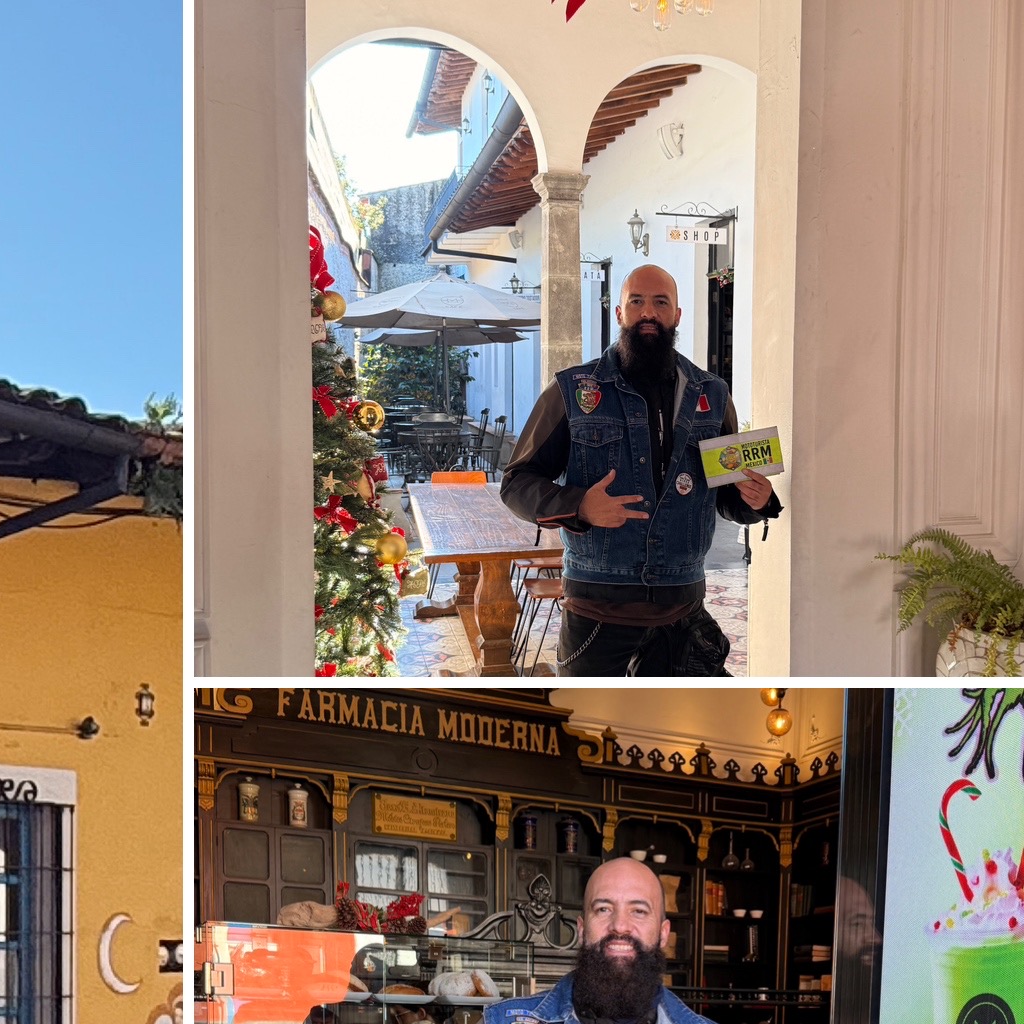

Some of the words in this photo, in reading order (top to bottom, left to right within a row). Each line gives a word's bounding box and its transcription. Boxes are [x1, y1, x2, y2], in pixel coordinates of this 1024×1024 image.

[683, 229, 720, 242] SHOP
[583, 271, 601, 280] ATA
[741, 439, 771, 449] MOTOTURISTA
[742, 445, 772, 462] RRM
[277, 688, 426, 736] FARMACIA
[437, 708, 561, 756] MODERNA
